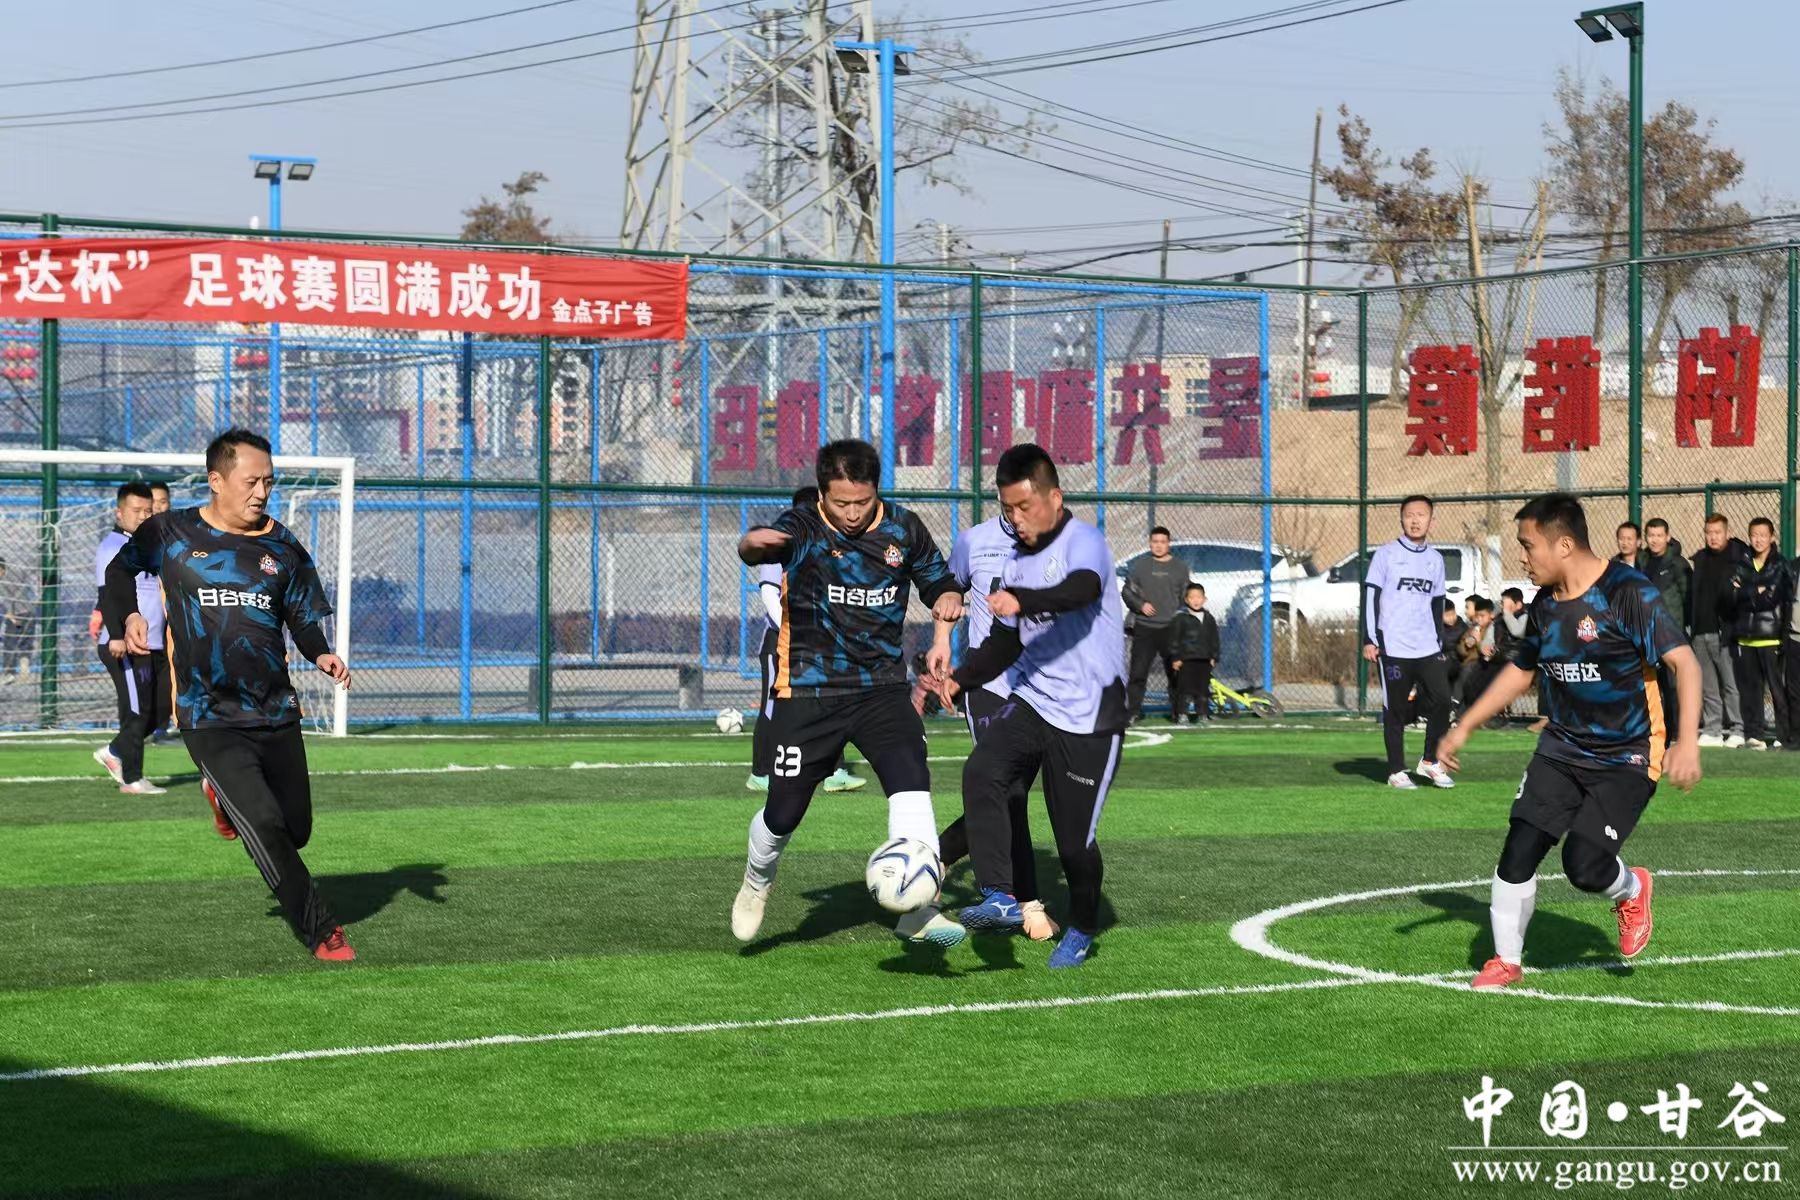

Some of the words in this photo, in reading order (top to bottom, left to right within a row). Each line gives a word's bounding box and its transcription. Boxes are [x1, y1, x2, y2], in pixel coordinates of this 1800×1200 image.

[0, 249, 149, 304] 达杯”
[184, 253, 541, 320] 足球赛圆满成功
[552, 298, 653, 326] 金点子广告
[774, 744, 802, 777] 23
